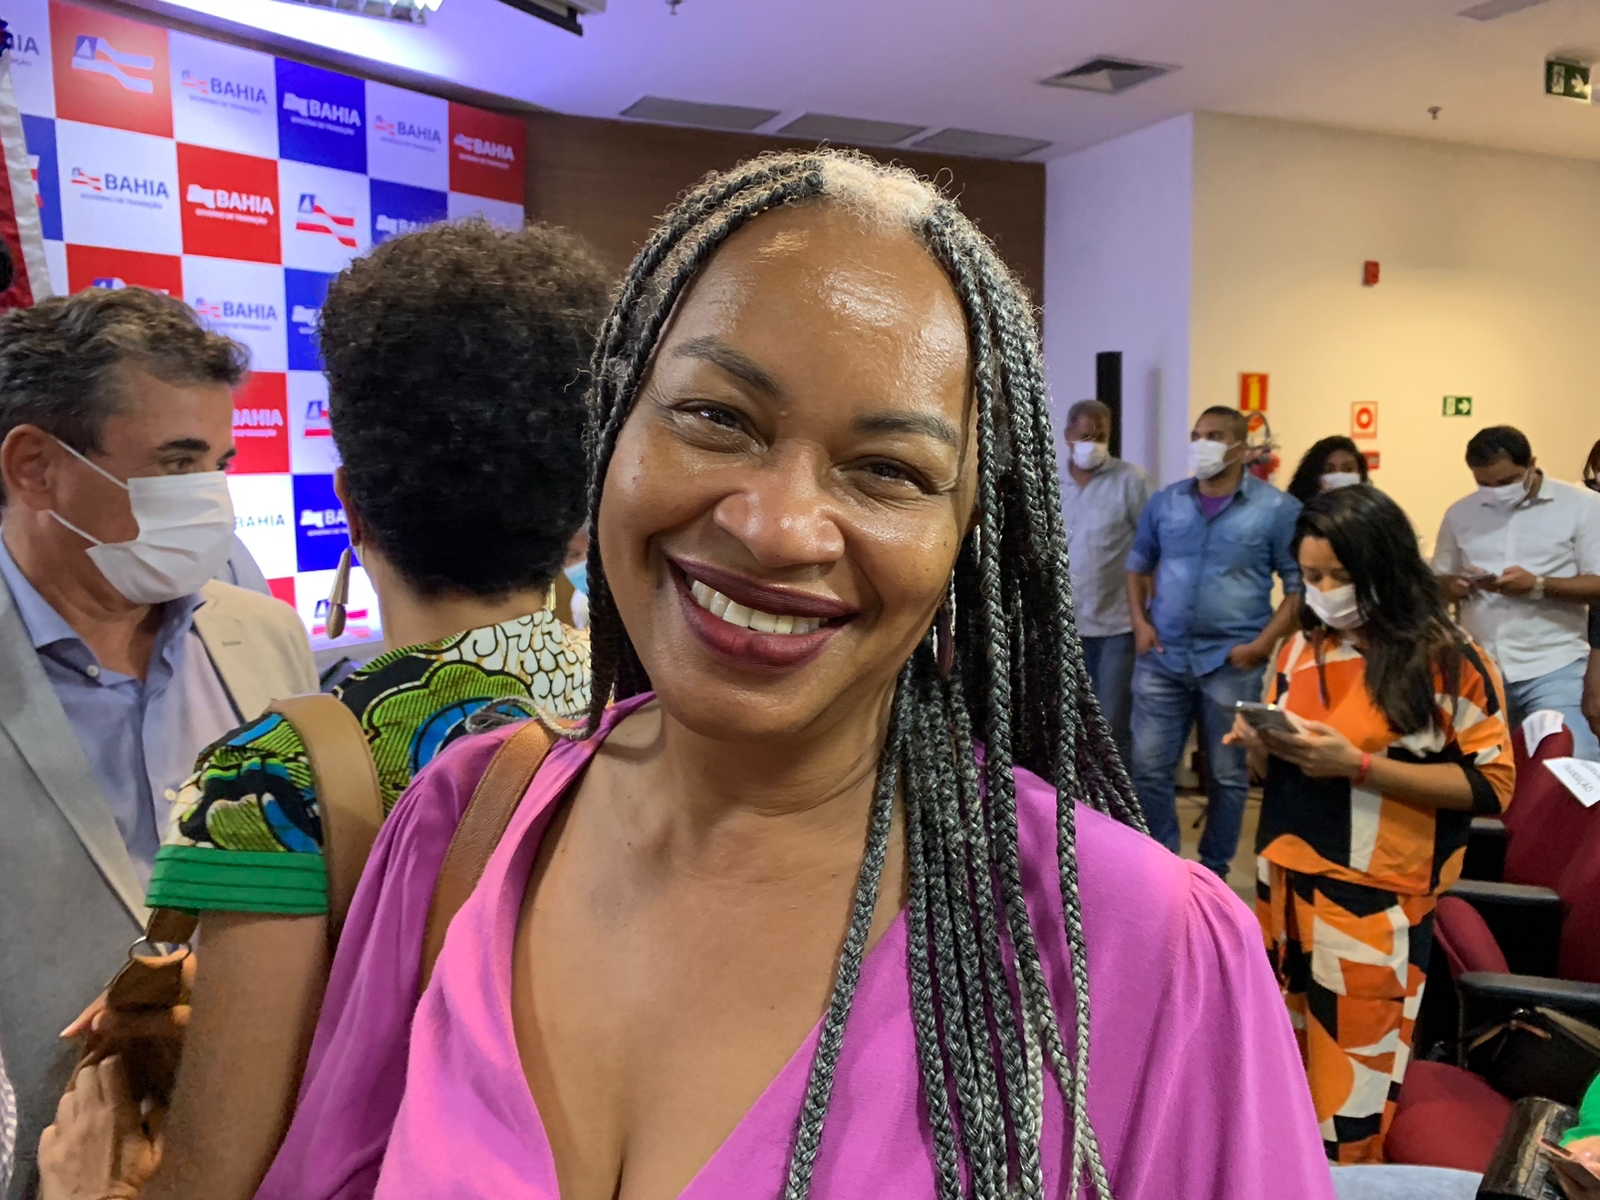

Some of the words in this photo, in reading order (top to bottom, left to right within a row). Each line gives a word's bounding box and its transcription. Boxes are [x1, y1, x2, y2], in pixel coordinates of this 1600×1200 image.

[210, 77, 267, 105] BAHIA
[309, 98, 362, 128] BAHIA
[397, 121, 442, 145] BAHIA
[474, 138, 515, 162] BAHIA
[104, 173, 170, 200] BAHIA
[216, 189, 275, 216] BAHIA
[222, 301, 278, 321] BAHIA
